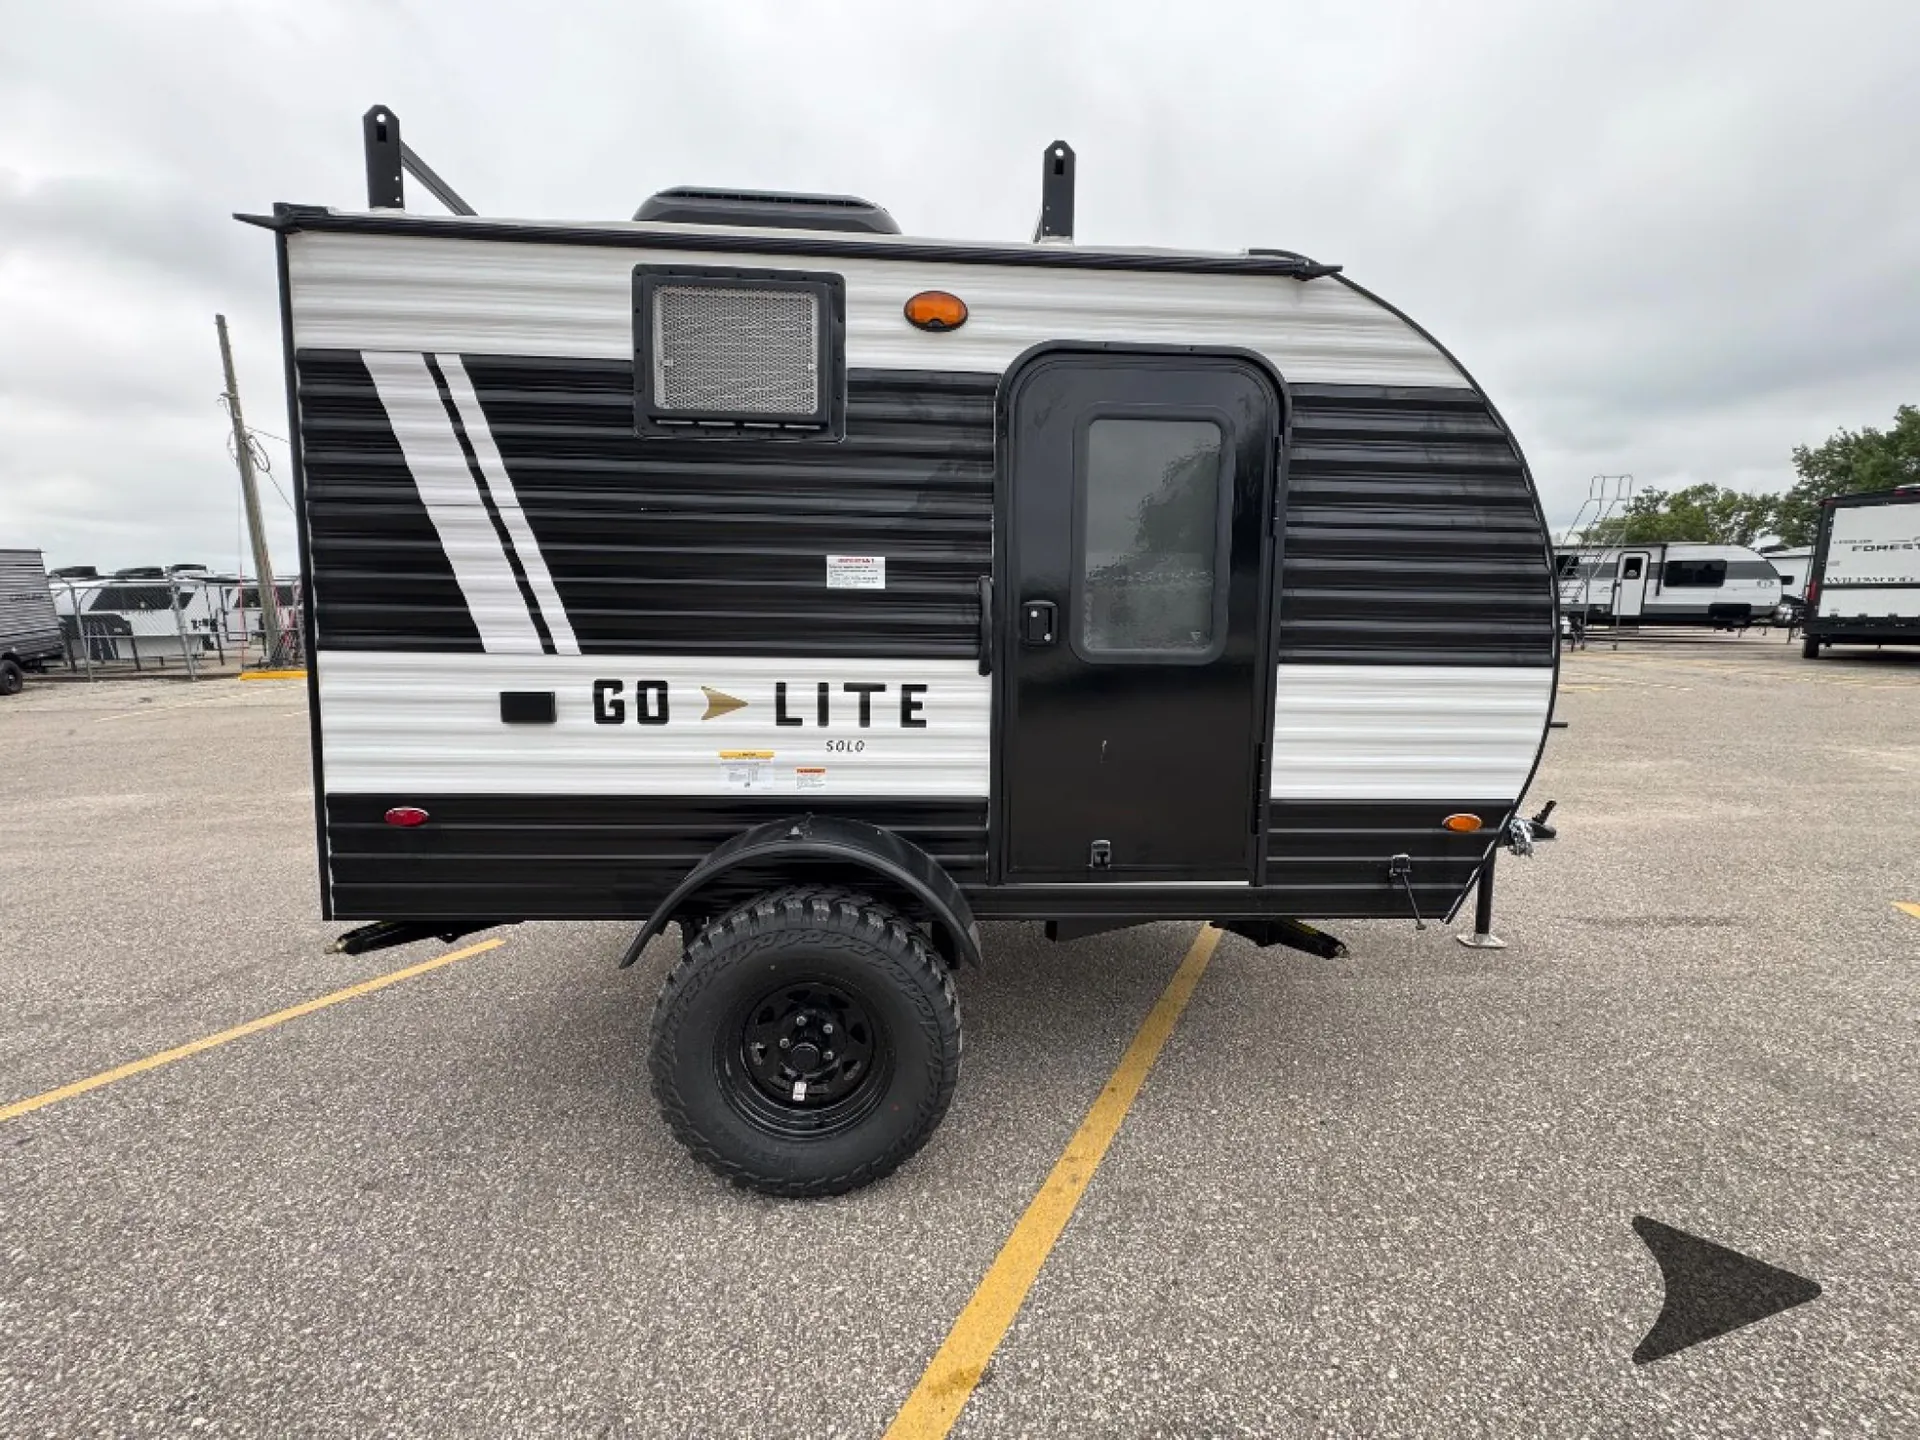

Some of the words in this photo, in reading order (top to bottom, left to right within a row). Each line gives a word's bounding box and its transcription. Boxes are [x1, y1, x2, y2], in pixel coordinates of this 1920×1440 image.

[593, 678, 670, 725] GO
[775, 682, 928, 728] LITE
[825, 740, 866, 753] SOLO
